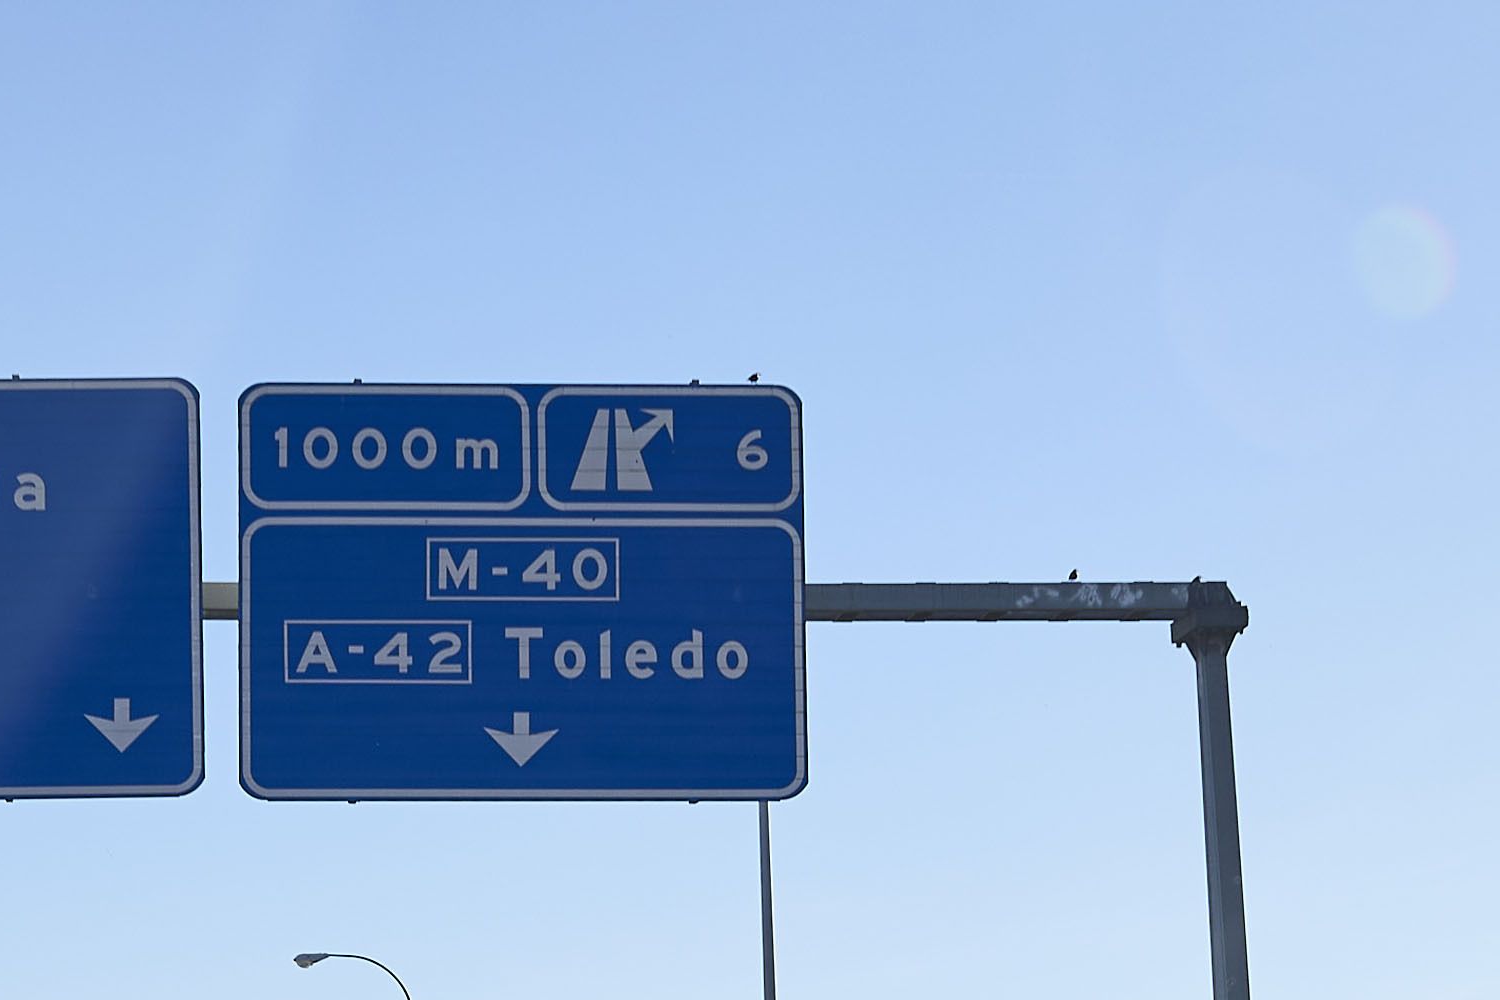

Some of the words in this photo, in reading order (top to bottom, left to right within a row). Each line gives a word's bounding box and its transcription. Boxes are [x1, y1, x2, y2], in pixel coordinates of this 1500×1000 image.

[737, 430, 768, 469] 6
[439, 548, 608, 590] M-40
[297, 631, 462, 673] A-42
[505, 628, 749, 679] Toledo
